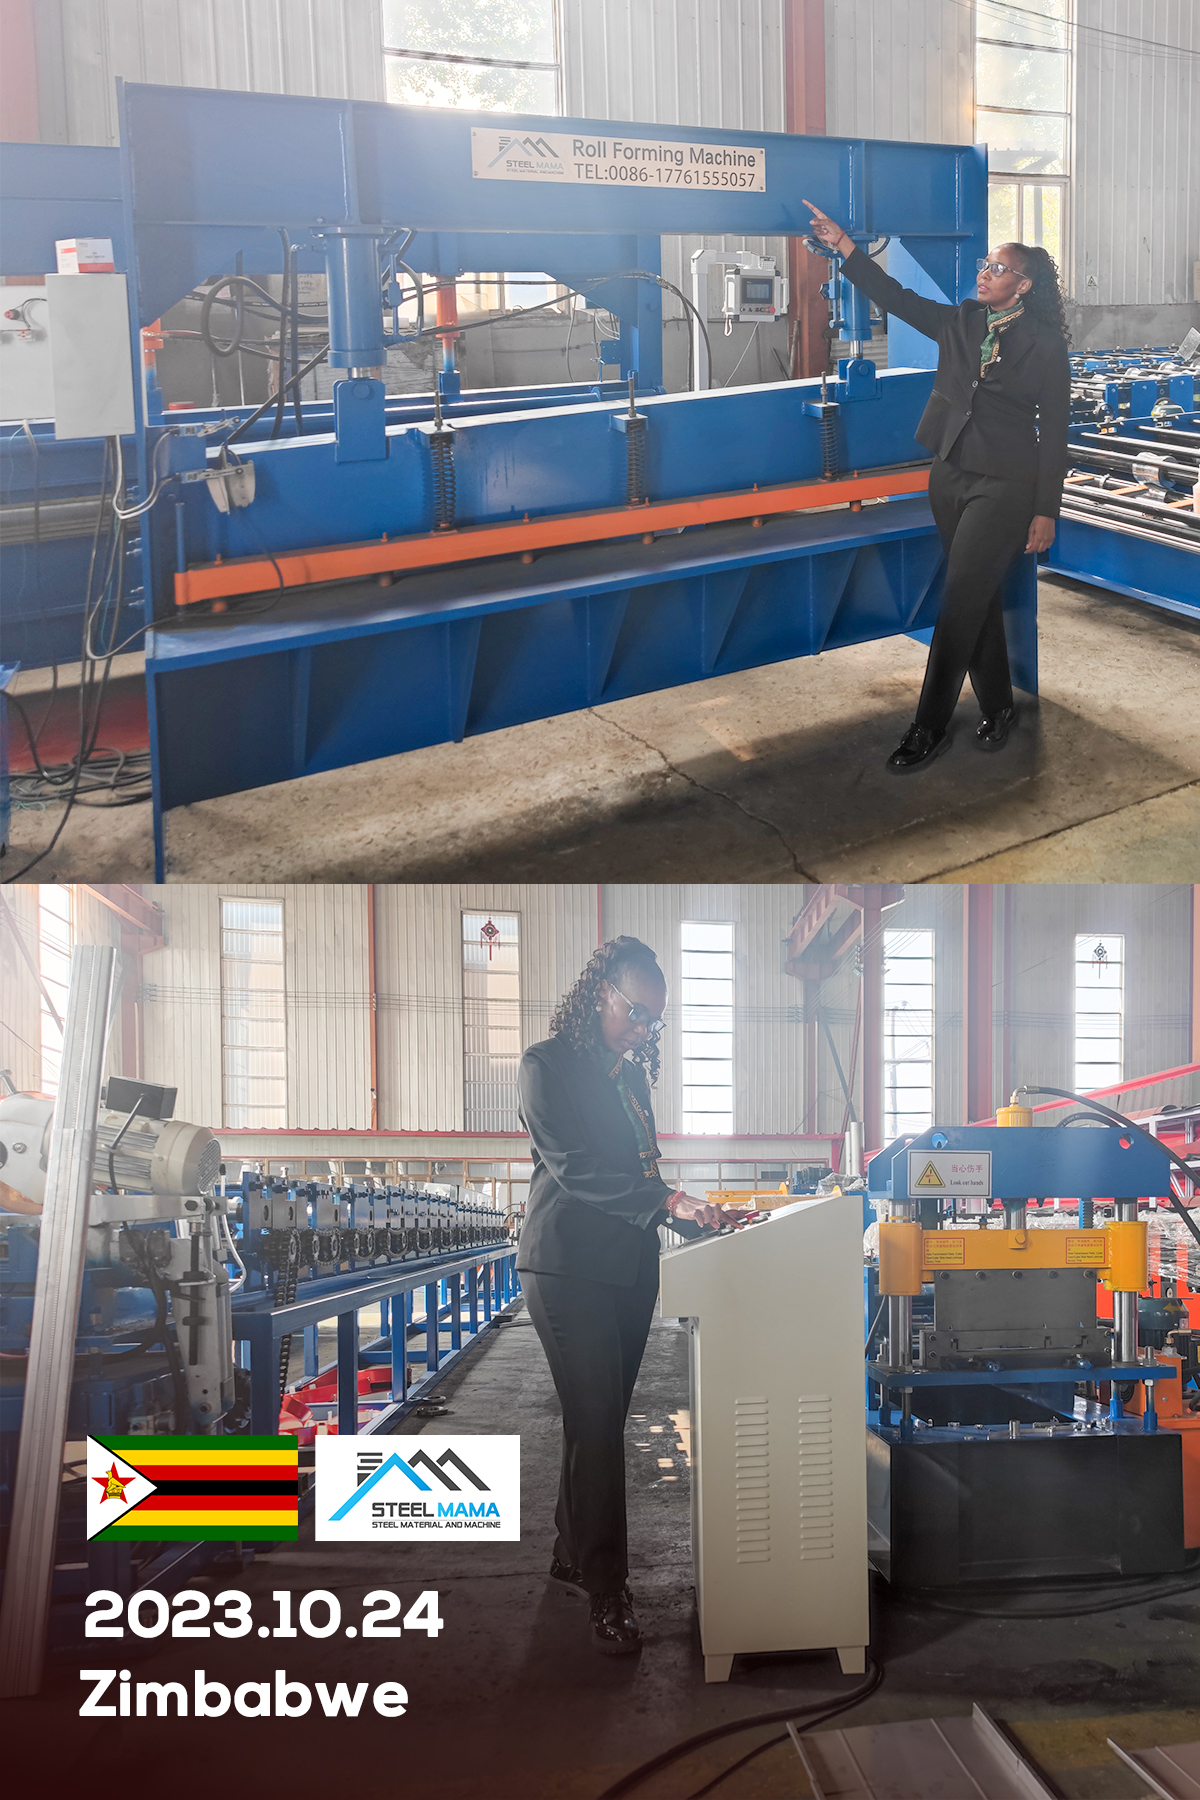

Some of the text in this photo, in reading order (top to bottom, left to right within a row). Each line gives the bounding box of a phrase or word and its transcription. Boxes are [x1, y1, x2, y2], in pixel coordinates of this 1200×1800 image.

[572, 138, 756, 168] Roll Forming Machine
[506, 159, 564, 170] STEEL MAMA
[573, 162, 756, 188] TEL:0086-17761555057
[951, 1164, 983, 1173] 当心伤手
